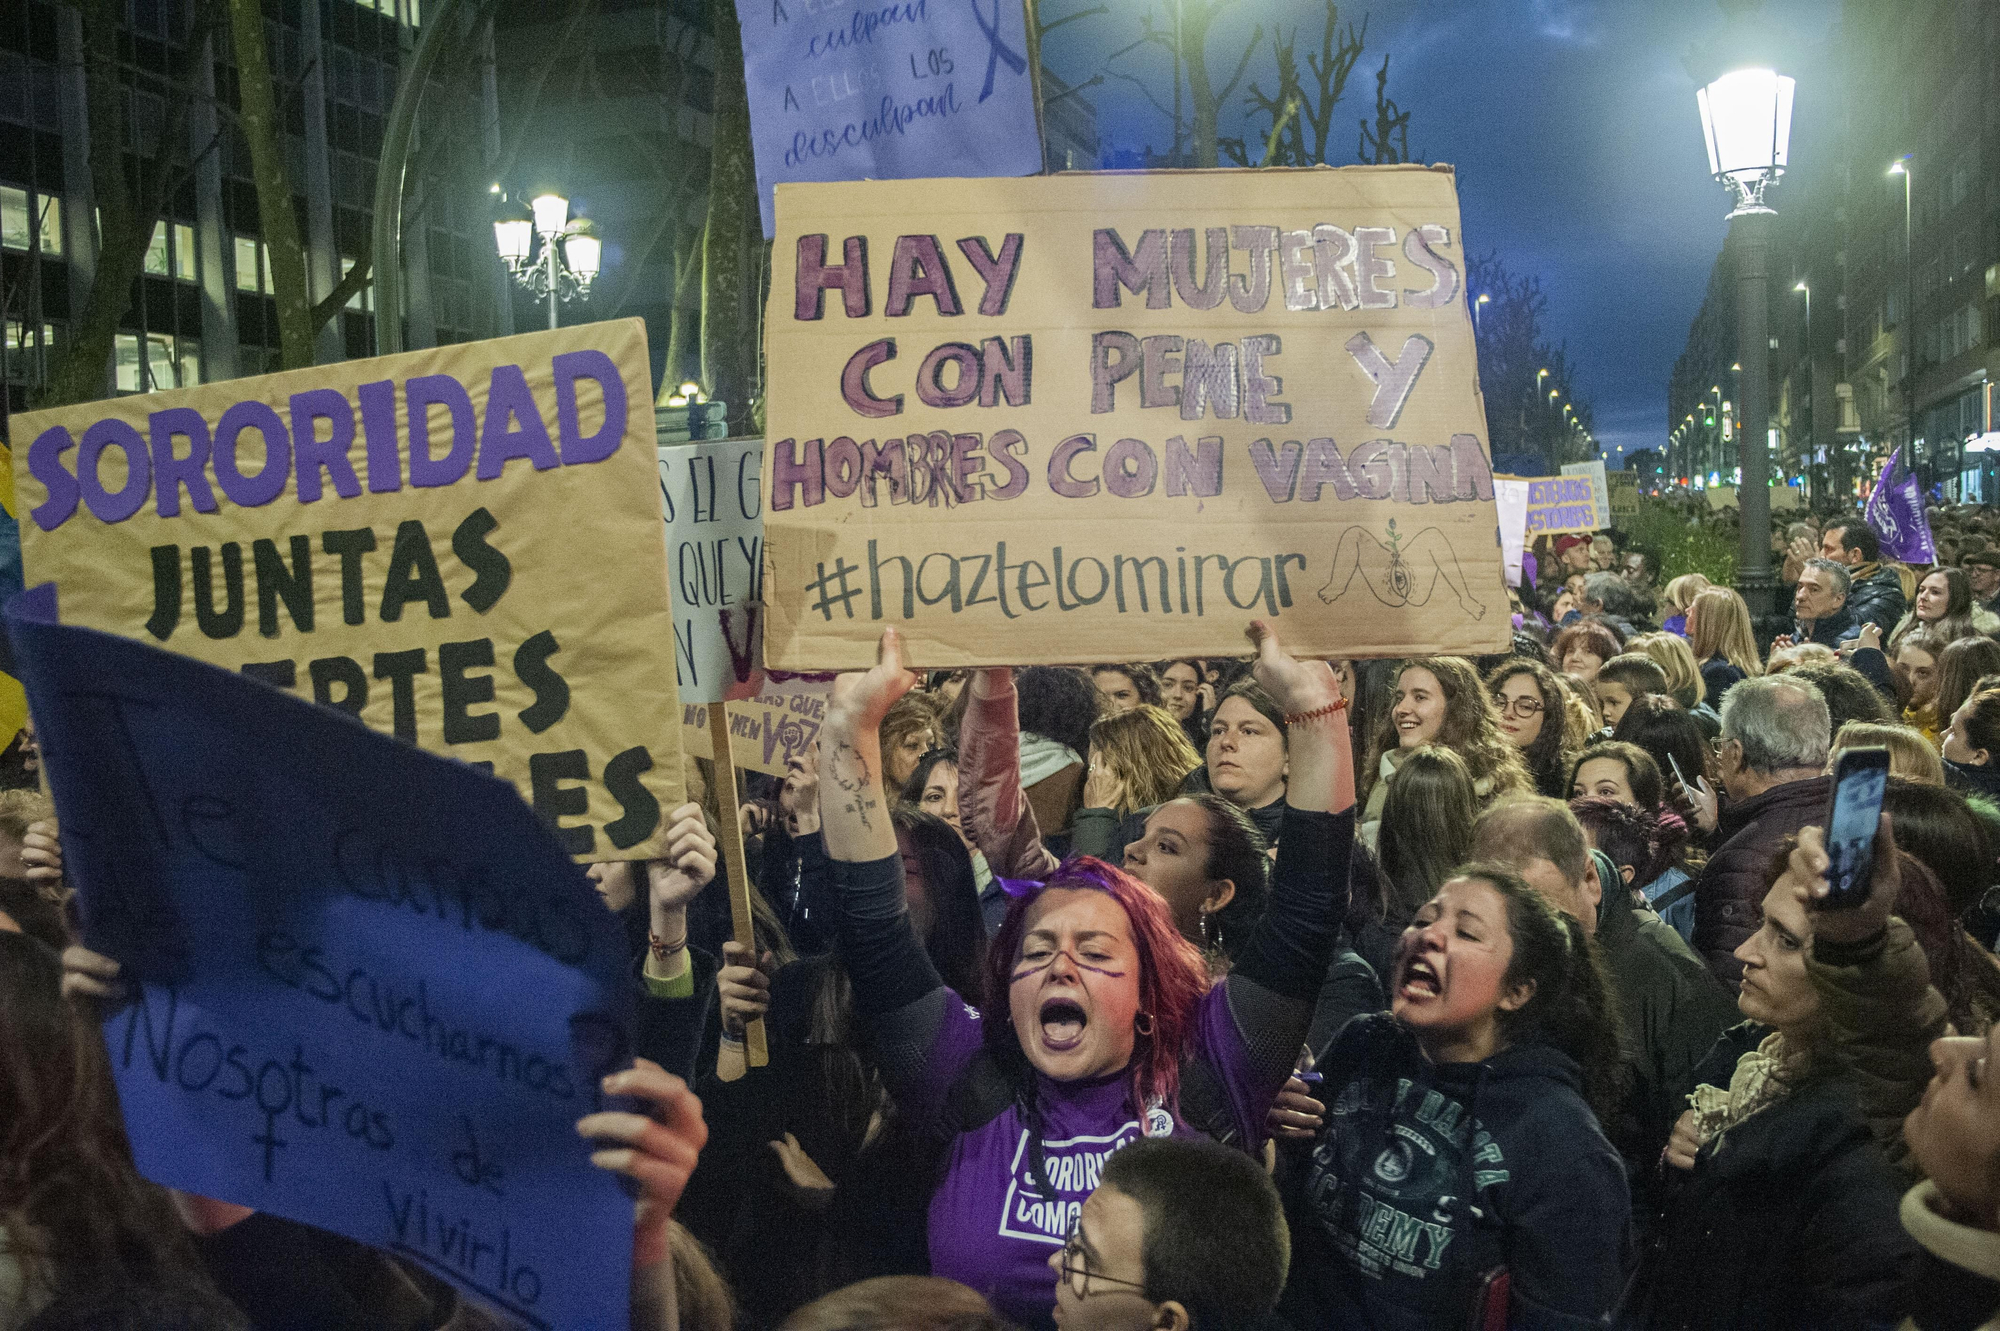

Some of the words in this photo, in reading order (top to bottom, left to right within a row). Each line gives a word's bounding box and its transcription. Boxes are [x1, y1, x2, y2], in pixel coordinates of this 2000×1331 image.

[784, 84, 800, 112] A
[910, 47, 955, 80] LOS
[794, 231, 1025, 321] HAY
[1091, 223, 1461, 313] MUJERES
[840, 333, 1034, 418] CON
[1090, 330, 1293, 424] PENE
[1344, 331, 1435, 430] Y
[27, 349, 628, 532] SORORIDAD
[771, 428, 1030, 511] HOMBRES
[1047, 432, 1224, 500] CON
[1247, 432, 1497, 505] VAGINA
[689, 455, 721, 524] EL
[145, 507, 512, 641] JUNTAS
[680, 537, 734, 608] QUE
[805, 539, 1307, 621] #haztelomirar
[789, 694, 824, 719] QUE
[452, 1114, 506, 1197] de
